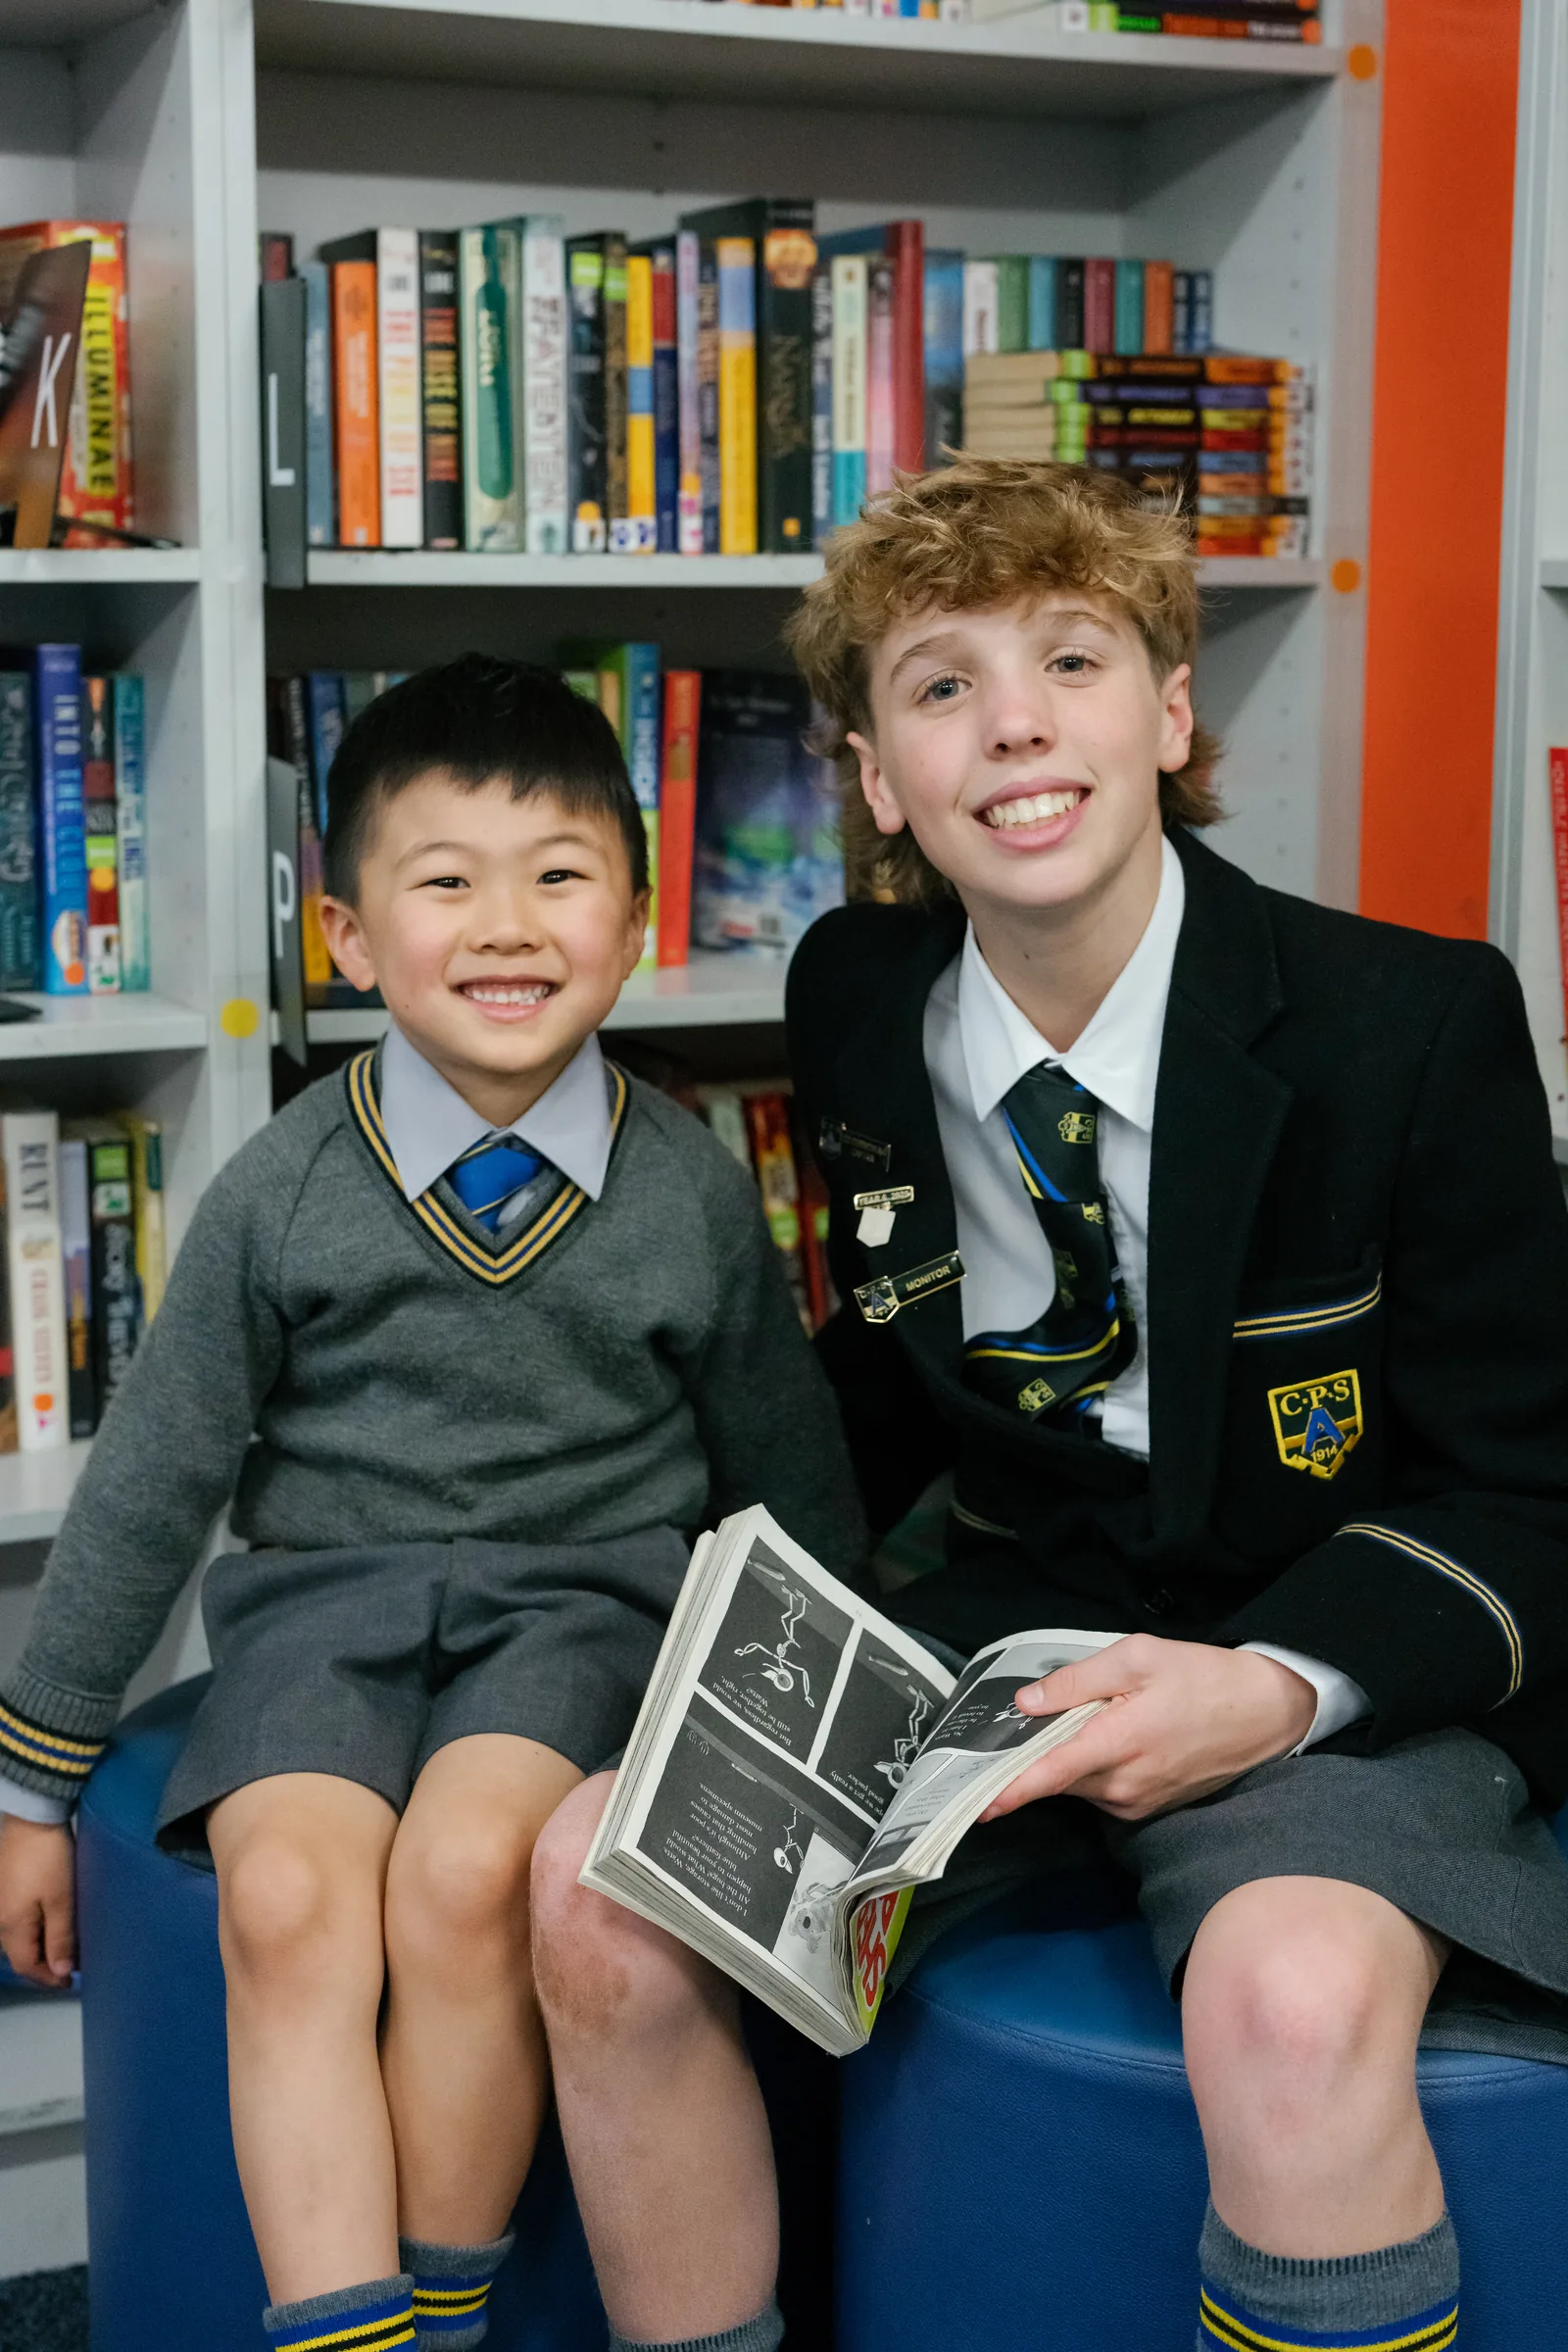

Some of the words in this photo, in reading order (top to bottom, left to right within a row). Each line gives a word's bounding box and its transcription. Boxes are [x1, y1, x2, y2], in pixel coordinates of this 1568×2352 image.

[30, 332, 72, 449] K
[269, 372, 294, 486] L
[54, 694, 81, 755] INTO
[56, 769, 82, 814] THE
[272, 850, 295, 958] P
[905, 1264, 951, 1292] MONITOR
[1310, 1444, 1338, 1463] 1914
[712, 1682, 732, 1700] would
[746, 1688, 768, 1707] Watts?
[776, 1721, 791, 1732] still
[779, 1734, 792, 1746] But
[829, 1770, 849, 1788] really
[854, 1789, 865, 1800] get
[691, 1800, 711, 1819] causes
[709, 1803, 735, 1825] damage
[690, 1813, 707, 1827] poor
[711, 1817, 725, 1831] that
[734, 1809, 762, 1832] museum
[736, 1823, 753, 1838] most
[666, 1838, 686, 1856] would
[672, 1830, 701, 1856] beautiful
[717, 1835, 751, 1860] Although
[726, 1827, 757, 1854] handling
[688, 1854, 706, 1874] What
[701, 1854, 717, 1868] your
[721, 1856, 737, 1872] blue
[726, 1872, 752, 1893] happen
[726, 1885, 738, 1895] the
[710, 1886, 723, 1899] like
[738, 1893, 751, 1904] All
